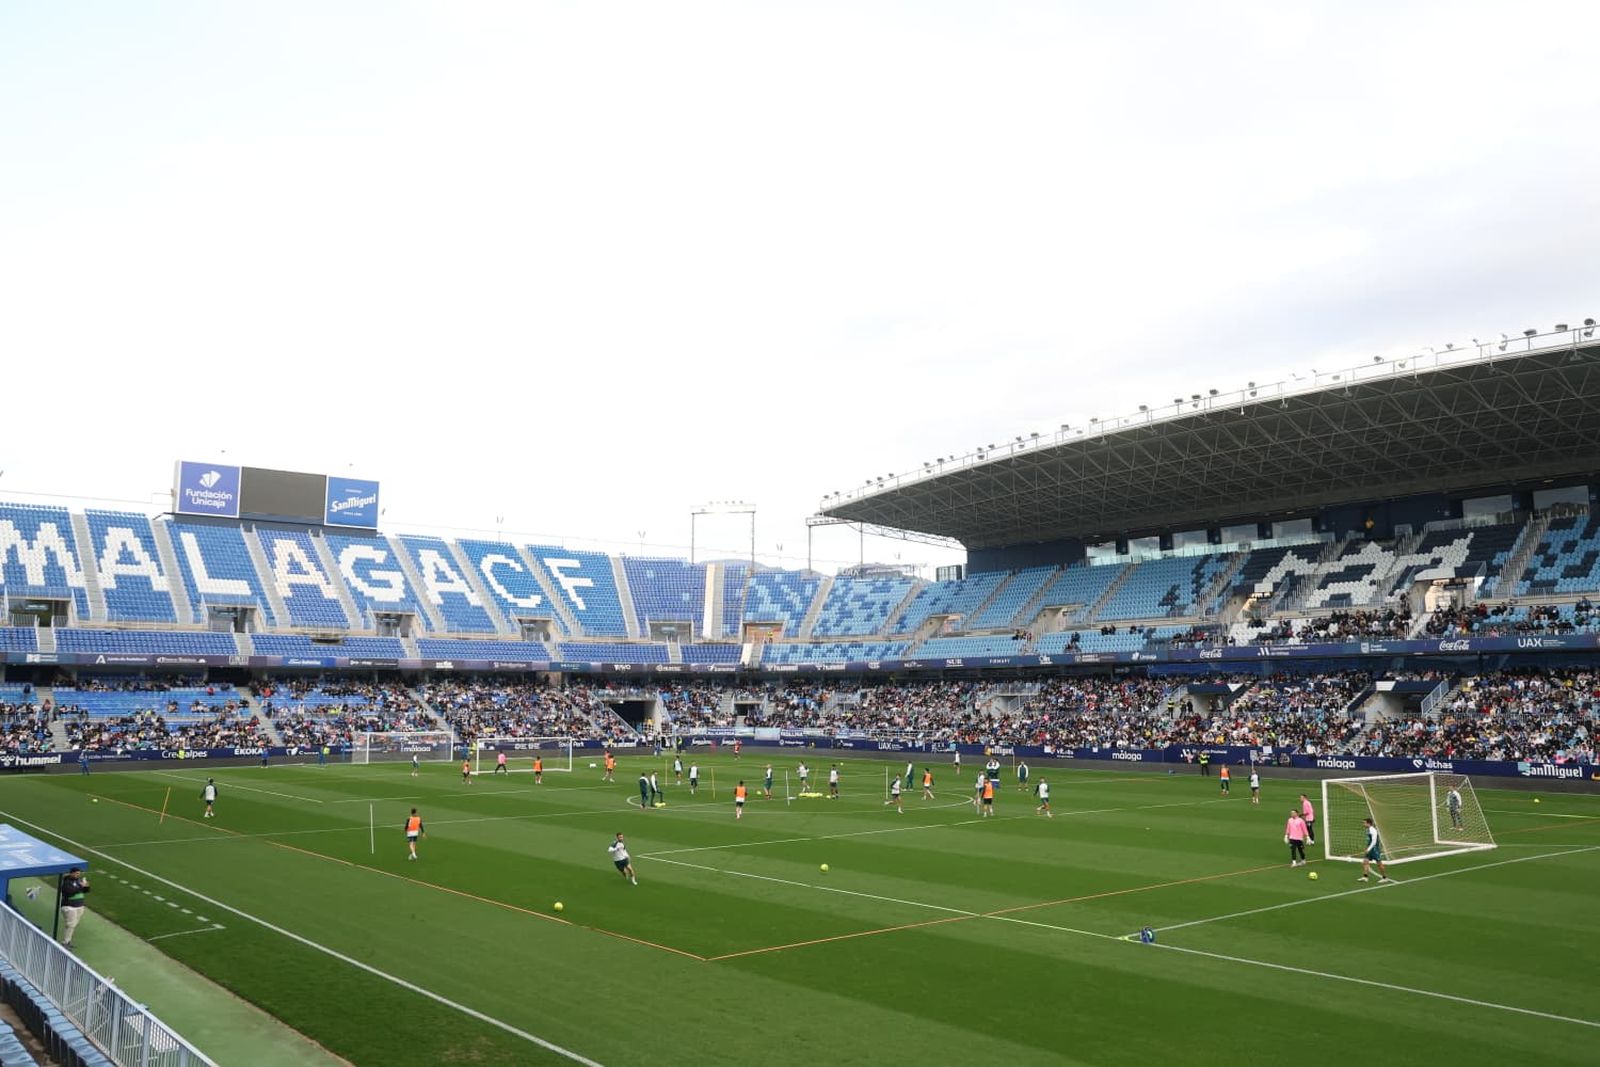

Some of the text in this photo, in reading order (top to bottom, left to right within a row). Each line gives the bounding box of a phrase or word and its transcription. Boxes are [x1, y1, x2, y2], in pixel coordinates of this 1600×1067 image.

[186, 488, 232, 500] Fundación
[192, 498, 226, 508] Unicaja
[1517, 638, 1542, 648] UAX
[878, 742, 892, 750] UAX
[15, 754, 62, 766] hummel
[1112, 750, 1142, 761] málaga
[1317, 756, 1356, 769] málaga
